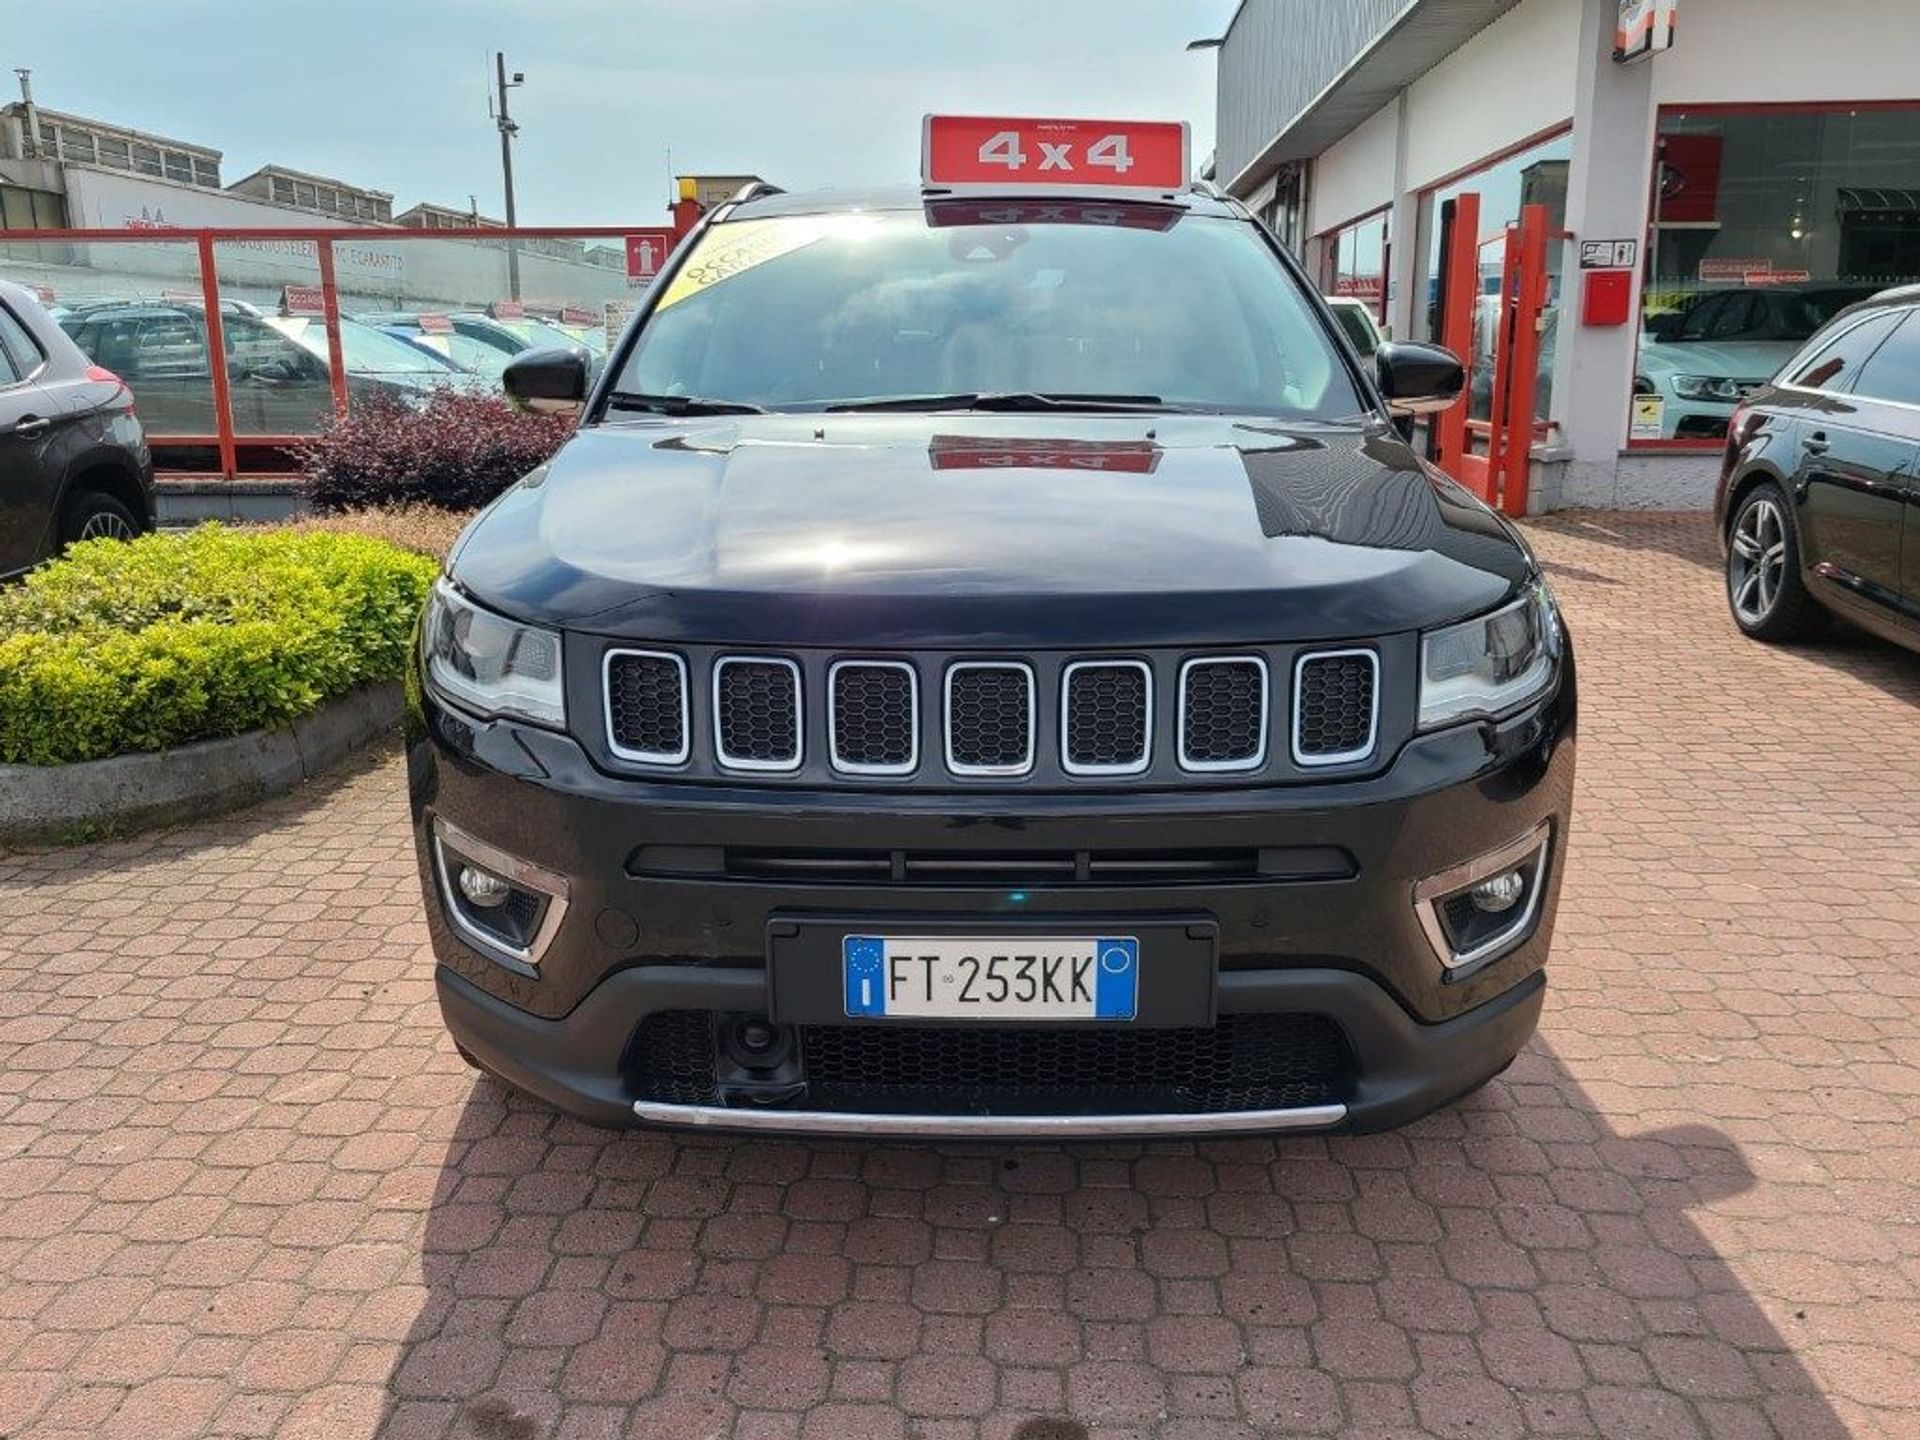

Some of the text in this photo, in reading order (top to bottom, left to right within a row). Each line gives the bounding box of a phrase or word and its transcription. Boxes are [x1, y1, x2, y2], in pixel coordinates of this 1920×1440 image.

[978, 131, 1027, 170] 4
[1087, 134, 1134, 172] 4
[889, 956, 940, 1002] FT
[957, 956, 1093, 1002] 253KK
